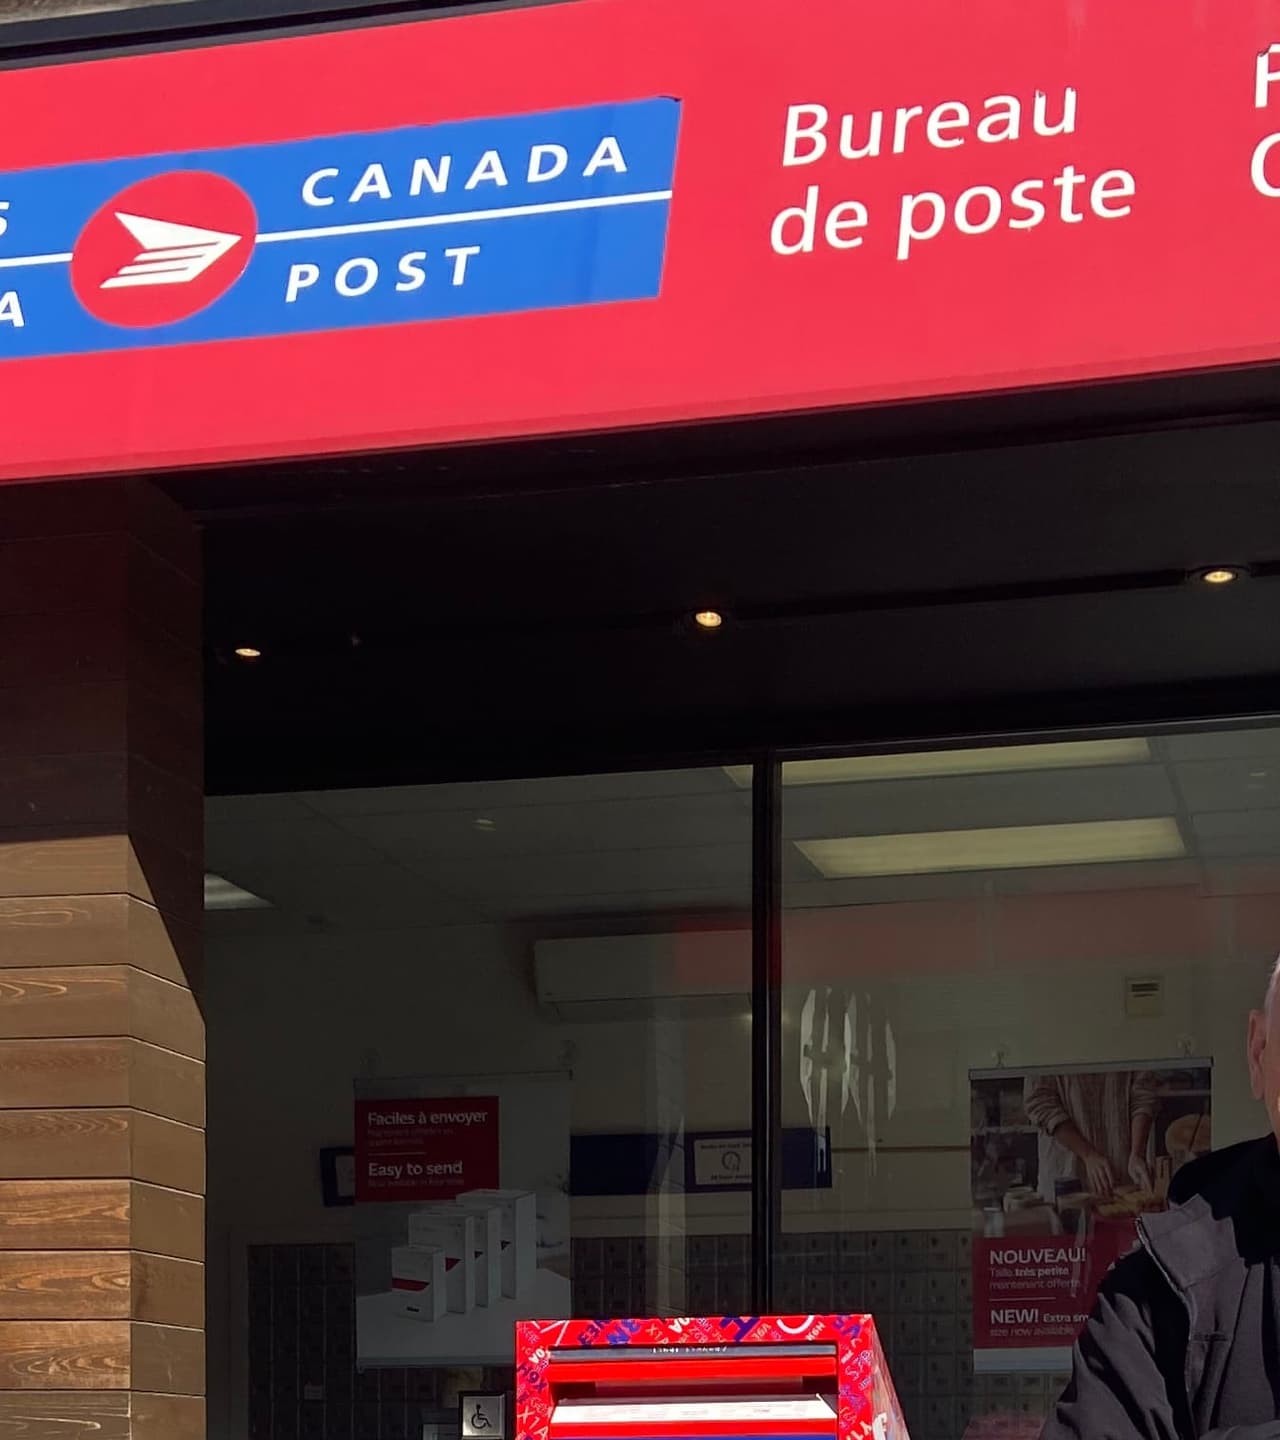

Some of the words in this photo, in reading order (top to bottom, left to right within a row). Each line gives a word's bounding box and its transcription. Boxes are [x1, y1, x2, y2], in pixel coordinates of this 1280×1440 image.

[781, 86, 1079, 168] Bureau
[301, 134, 629, 210] CANADA
[769, 186, 870, 257] de
[895, 165, 1137, 261] poste
[284, 245, 482, 304] POST
[368, 1112, 415, 1126] Faciles
[418, 1112, 426, 1124] à
[430, 1112, 488, 1126] envoyer
[368, 1162, 403, 1179] Easy
[407, 1163, 422, 1175] to
[426, 1160, 463, 1174] send
[990, 1248, 1086, 1264] NOUVEAU!
[991, 1308, 1039, 1324] NEW!
[517, 1406, 548, 1440] X1A
